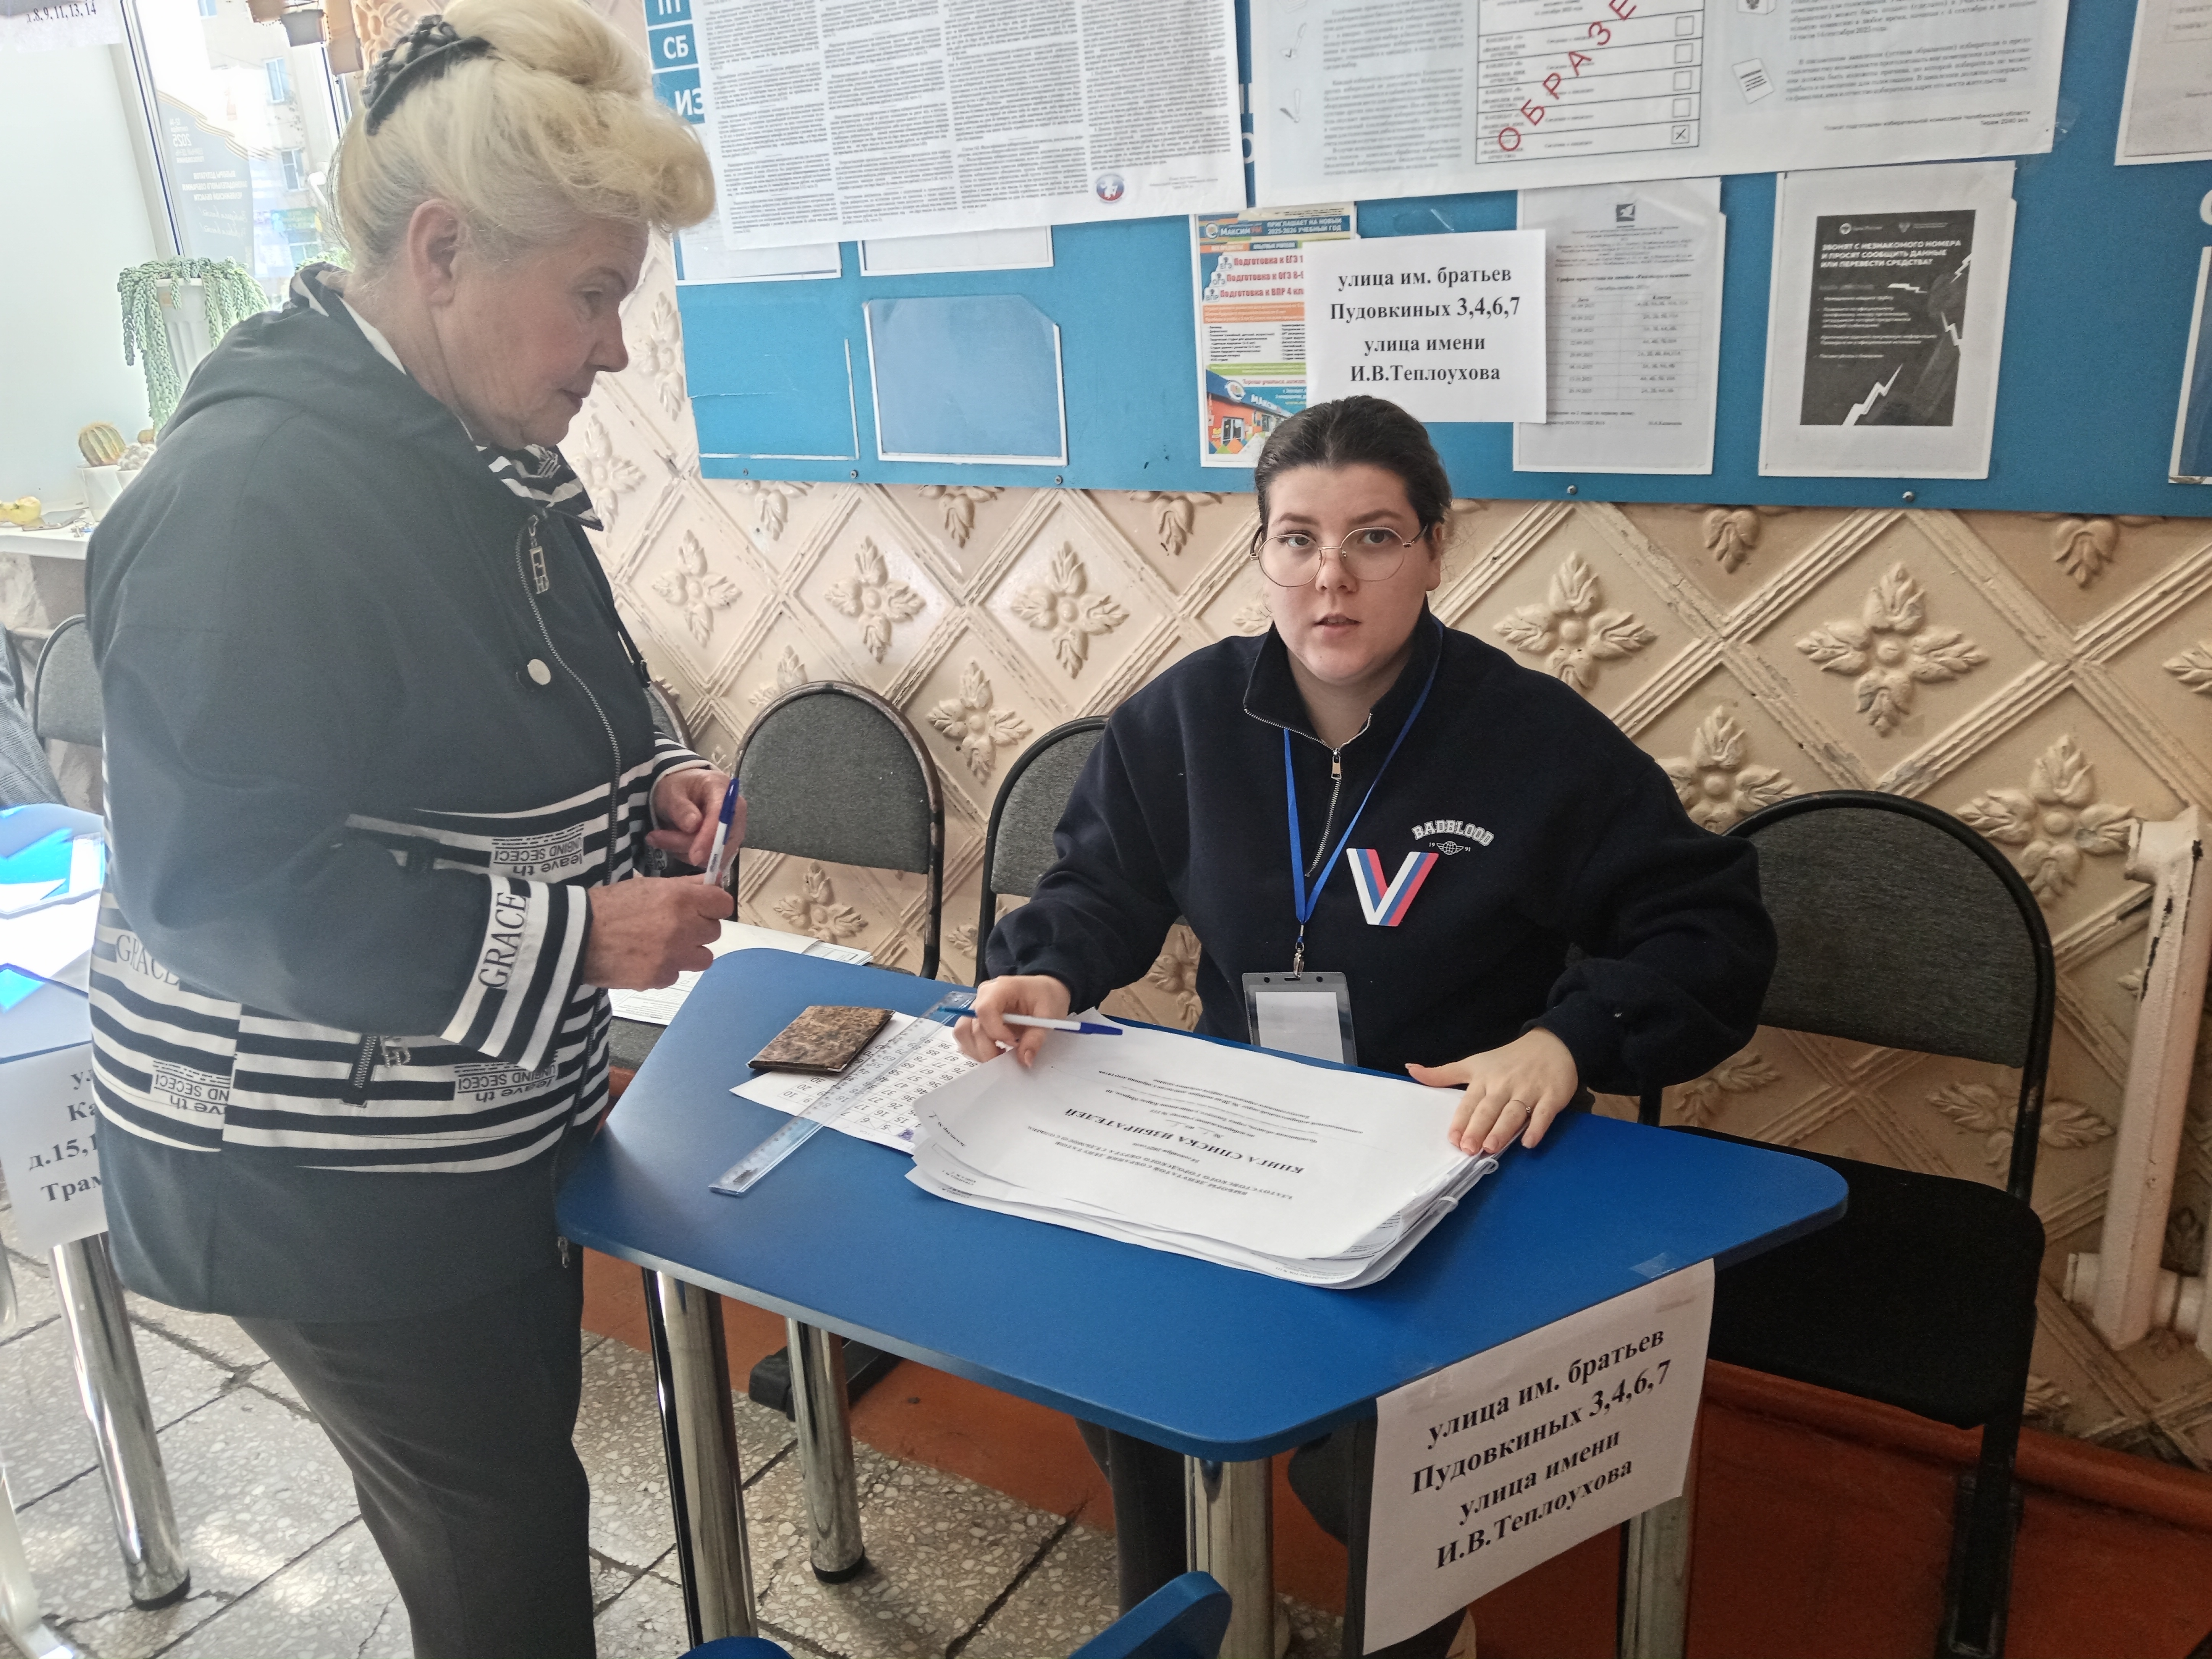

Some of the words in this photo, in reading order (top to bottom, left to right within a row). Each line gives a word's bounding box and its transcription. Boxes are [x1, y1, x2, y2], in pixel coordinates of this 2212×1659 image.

[43, 7, 53, 21] 9,
[54, 6, 68, 18] 11,
[70, 3, 83, 17] 13,
[85, 3, 96, 15] 14
[663, 35, 689, 59] СБ
[1861, 241, 1924, 249] НЕЗНАКОМОГО
[1234, 257, 1277, 266] Подготовка
[1286, 255, 1297, 264] ЕГЭ
[1227, 273, 1270, 283] Подготовка
[1337, 270, 1394, 291] улица
[1400, 271, 1431, 285] им.
[1437, 267, 1512, 288] братьев
[1220, 289, 1263, 298] Подготовка
[1271, 288, 1285, 296] ВПР
[1330, 303, 1451, 323] Пудовкиных
[1457, 296, 1520, 319] 3,4,6,7
[1364, 340, 1420, 356] улица
[1426, 337, 1485, 351] имени
[1350, 365, 1501, 385] И.В.Теплоухова
[1411, 819, 1494, 847] BADBLOOD
[495, 848, 546, 862] SECECI
[541, 854, 583, 872] leave
[513, 865, 535, 876] th
[478, 893, 527, 988] GRACE
[155, 1074, 202, 1097] SECECI
[459, 1074, 507, 1090] SECECI
[501, 1078, 552, 1097] leave
[170, 1095, 188, 1110] th
[476, 1091, 496, 1103] th
[1065, 1109, 1173, 1139] ИЗБИРАТЕЛЕЙ
[1179, 1136, 1242, 1159] СПИСКА
[1249, 1157, 1303, 1173] КНИГА
[1428, 1397, 1510, 1449] улица
[1518, 1377, 1560, 1406] им.
[1568, 1330, 1664, 1386] братьев
[1411, 1408, 1583, 1494] Пудовкиных
[1589, 1360, 1672, 1417] 3,4,6,7
[1459, 1472, 1536, 1526] улица
[1545, 1431, 1620, 1480] имени
[1434, 1460, 1633, 1570] И.В.Теплоухова
